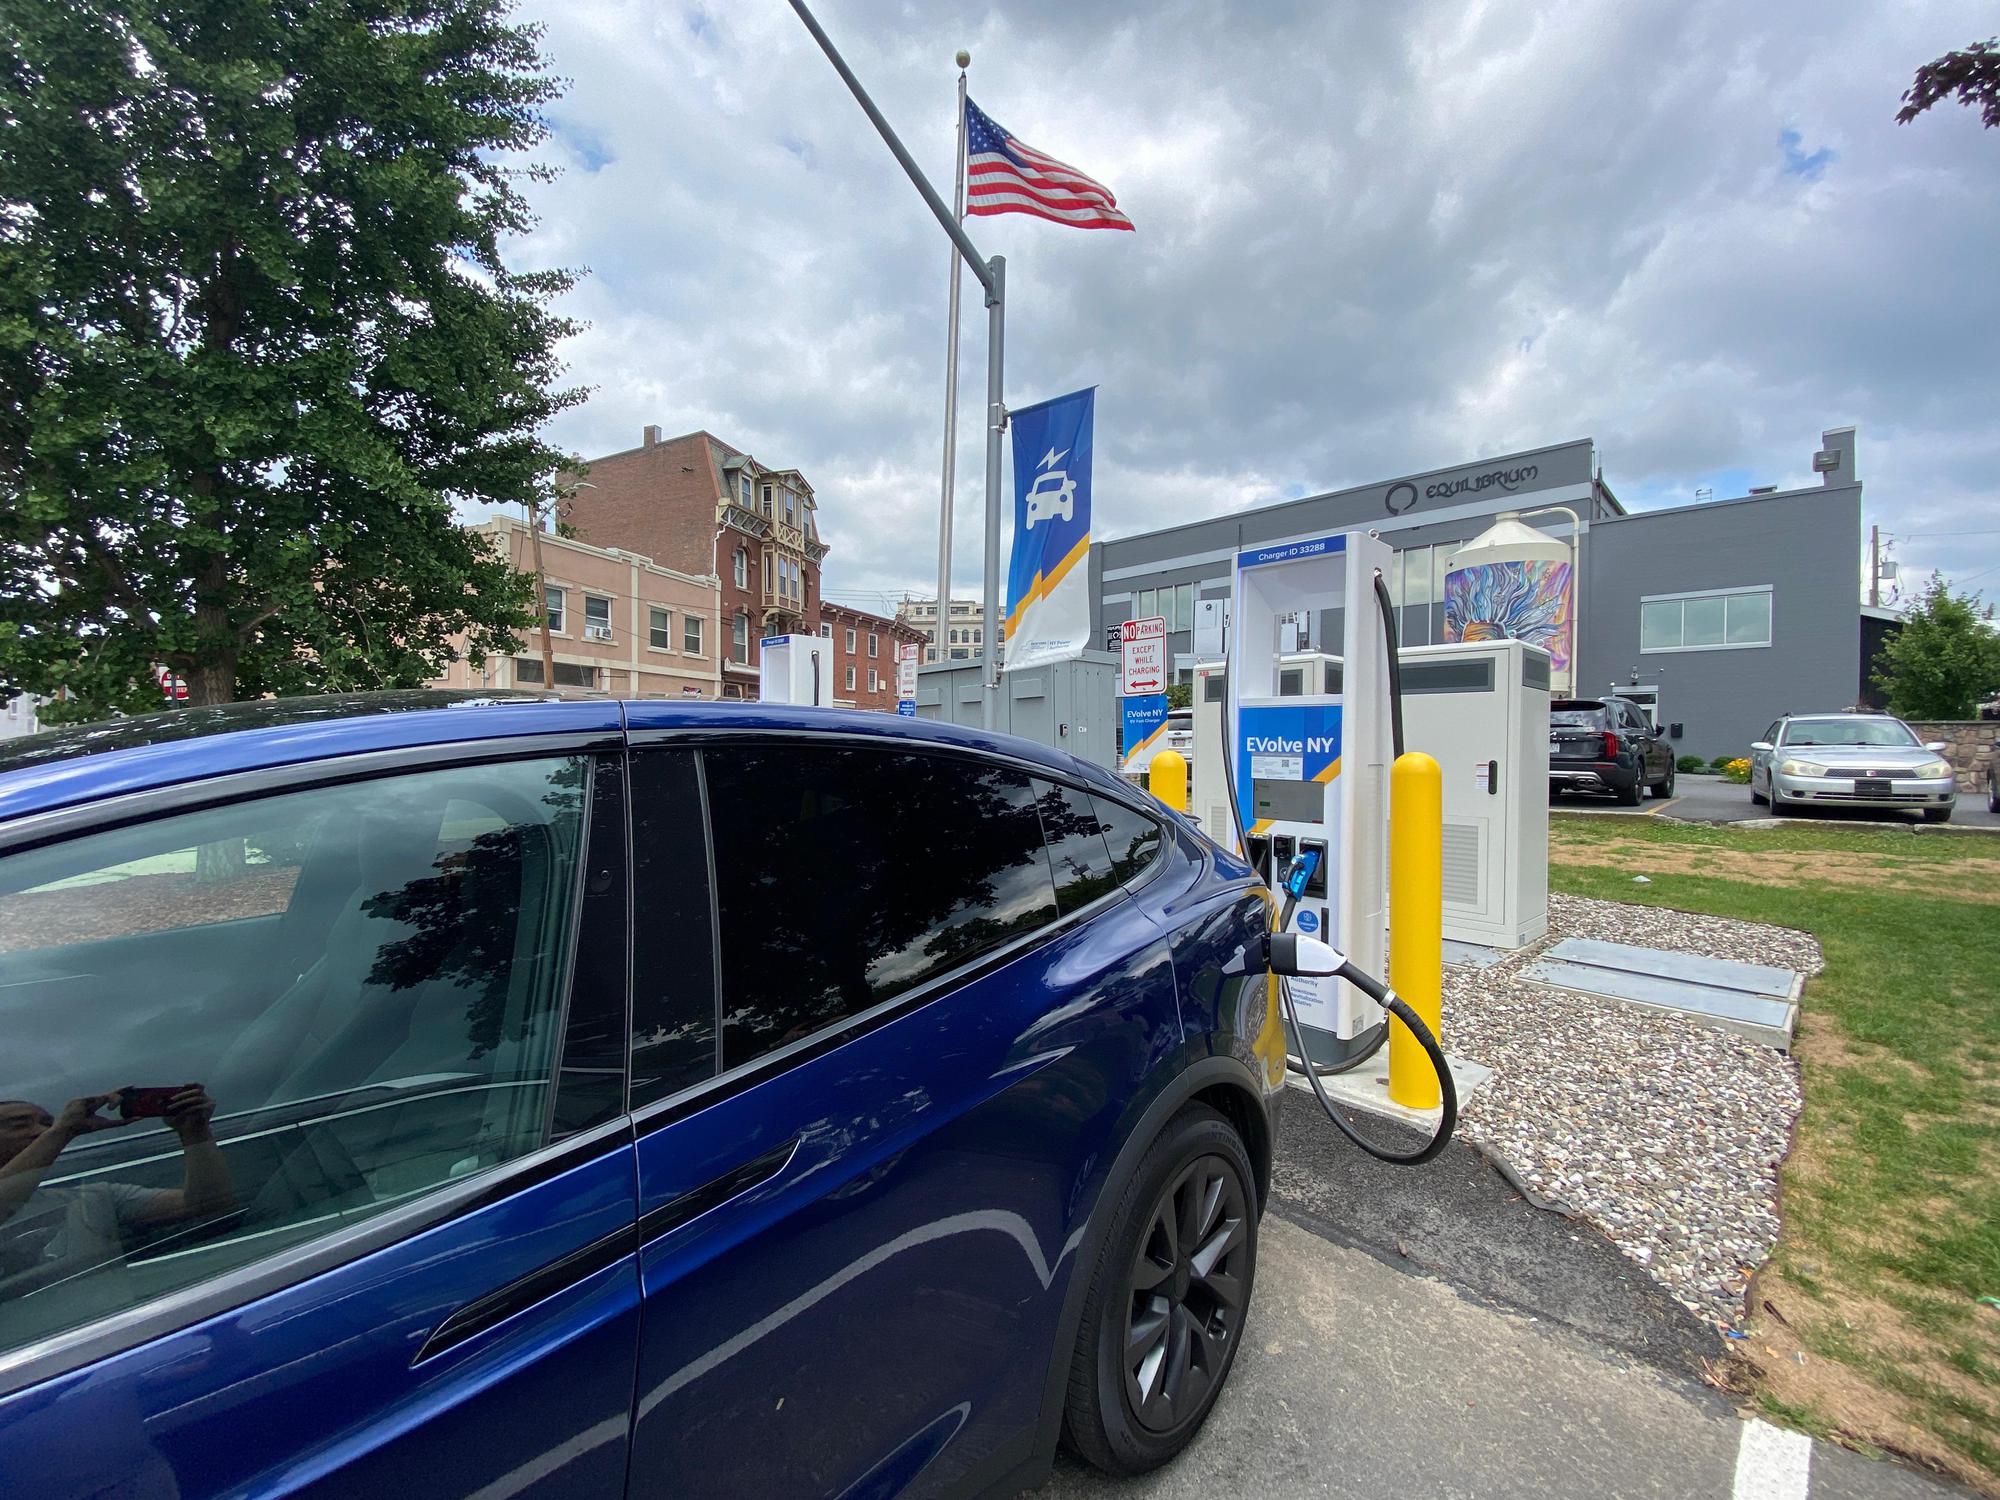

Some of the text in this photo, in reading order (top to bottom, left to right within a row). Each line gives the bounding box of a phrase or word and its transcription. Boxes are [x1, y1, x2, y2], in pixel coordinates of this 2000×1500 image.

[1426, 465, 1538, 498] EQUILIBRIUM
[1258, 543, 1325, 561] Charger ID 33288
[1123, 622, 1163, 640] NO PARKING
[1132, 645, 1155, 655] EXCEPT
[1135, 655, 1153, 664] WHILE
[1128, 665, 1160, 676] CHARGING
[1127, 708, 1164, 718] EVolve NY
[1246, 736, 1334, 753] EVolve NY
